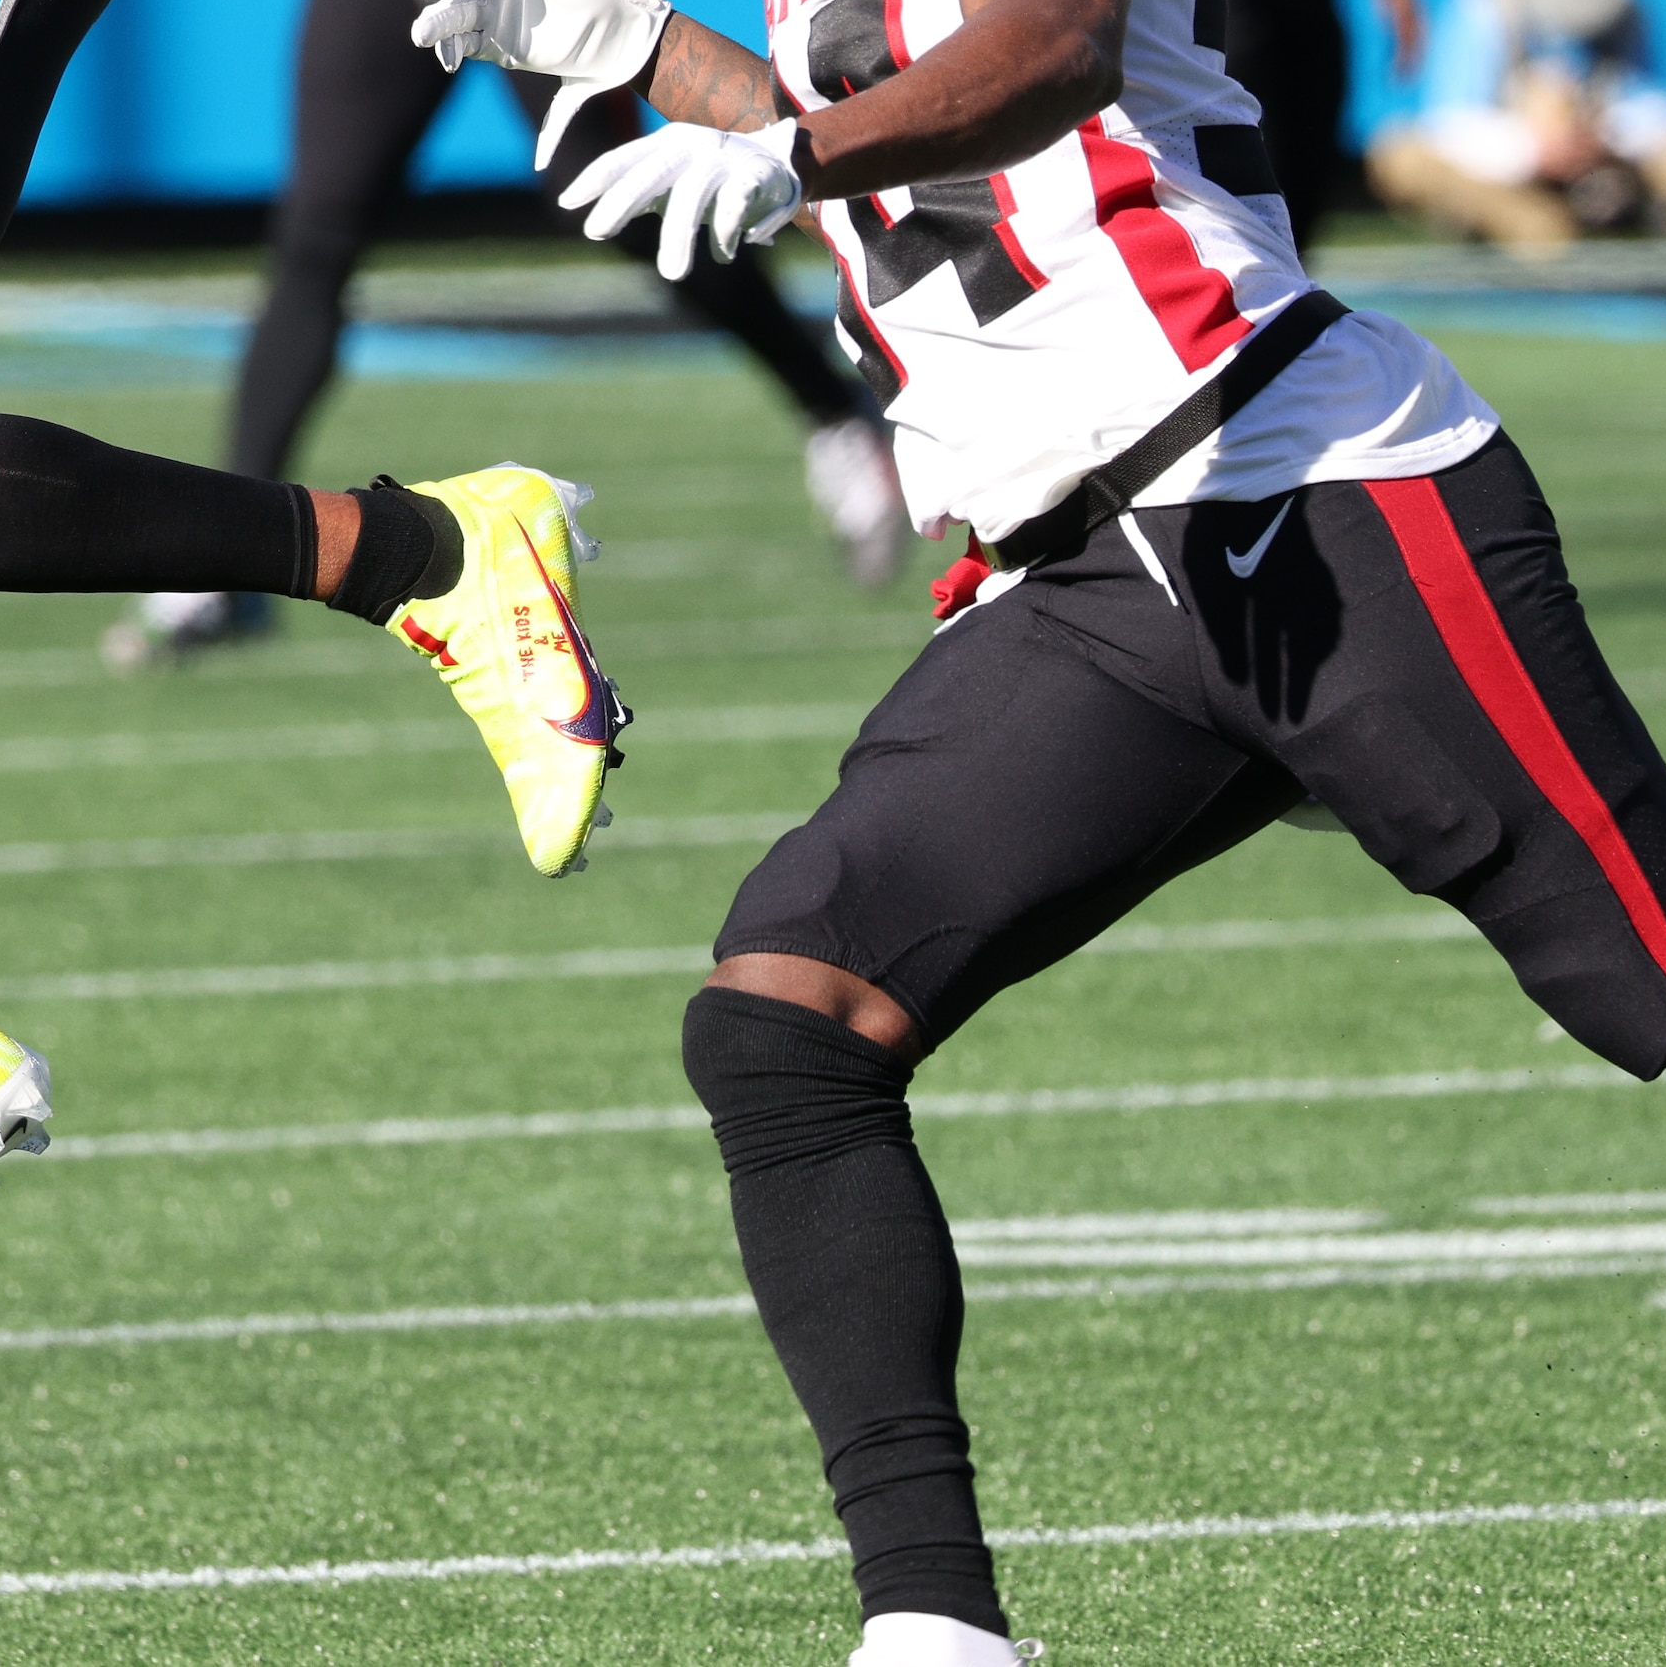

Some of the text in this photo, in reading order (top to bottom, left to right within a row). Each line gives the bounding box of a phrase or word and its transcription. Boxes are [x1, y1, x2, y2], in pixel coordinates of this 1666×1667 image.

[514, 606, 535, 682] THE KIDS
[534, 635, 549, 645] &
[551, 631, 571, 654] ME
